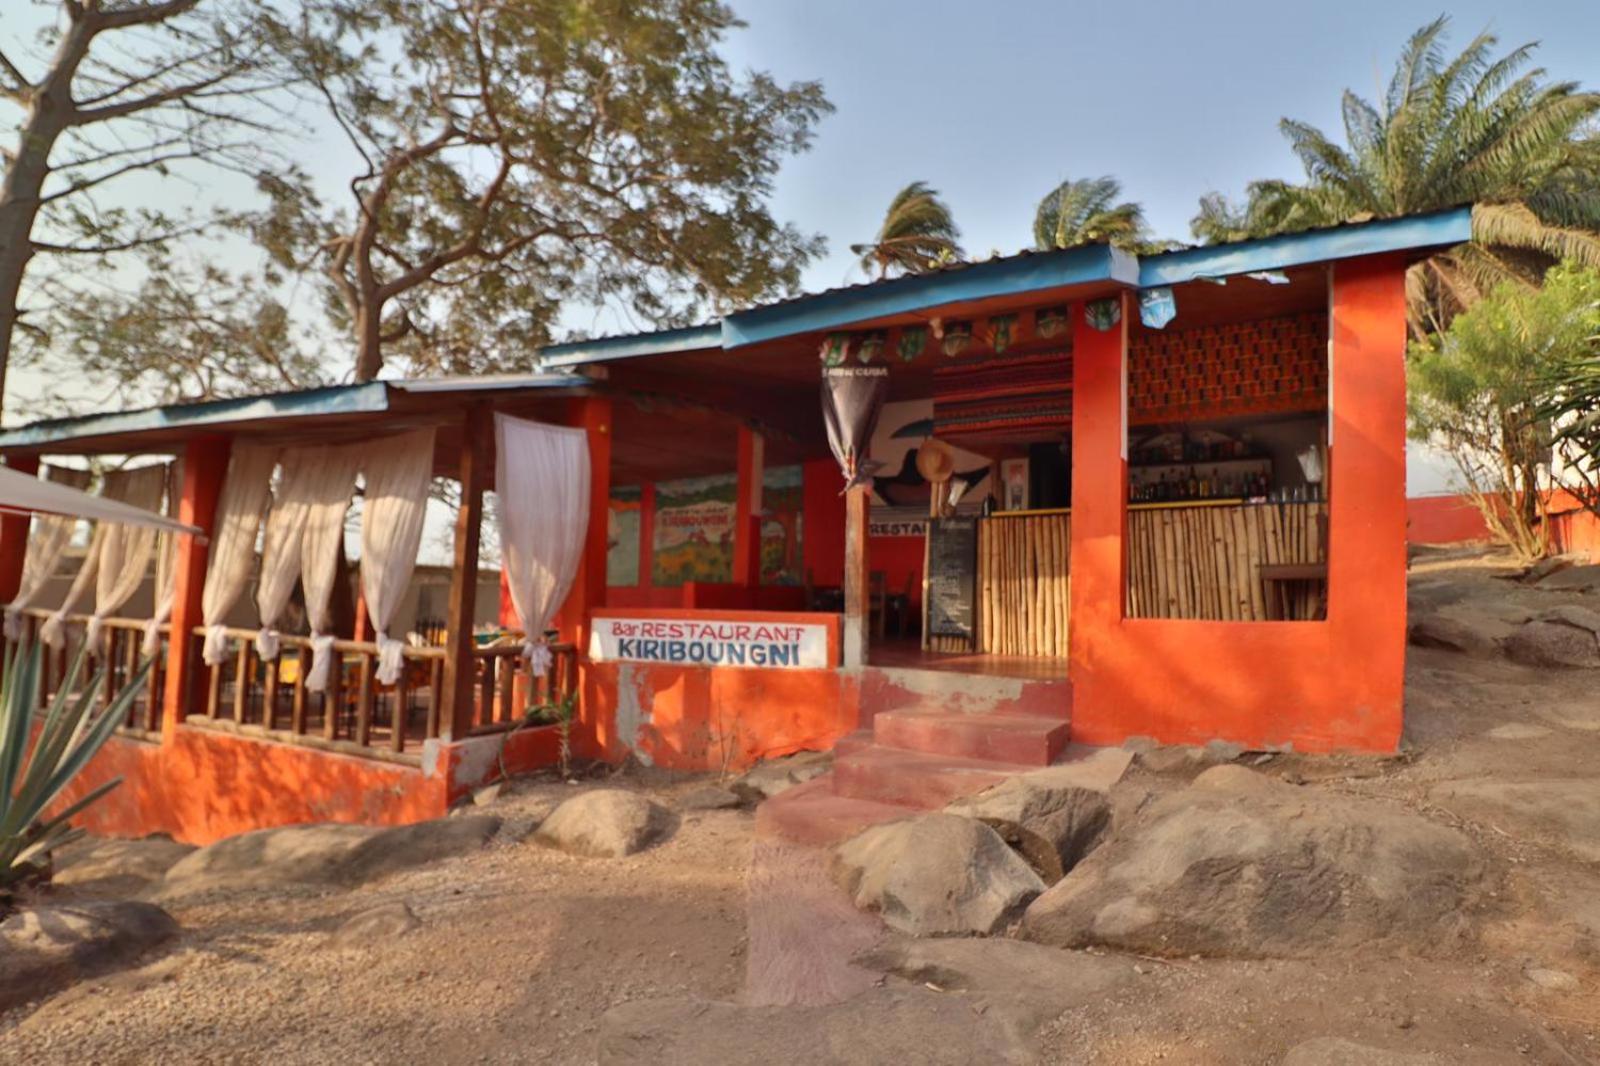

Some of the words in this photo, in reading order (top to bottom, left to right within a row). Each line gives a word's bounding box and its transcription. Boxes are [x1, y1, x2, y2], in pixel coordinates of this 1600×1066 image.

[612, 621, 639, 637] Bar
[641, 622, 805, 641] RESTAURANT
[618, 638, 800, 666] KIRIBOUNGNI
